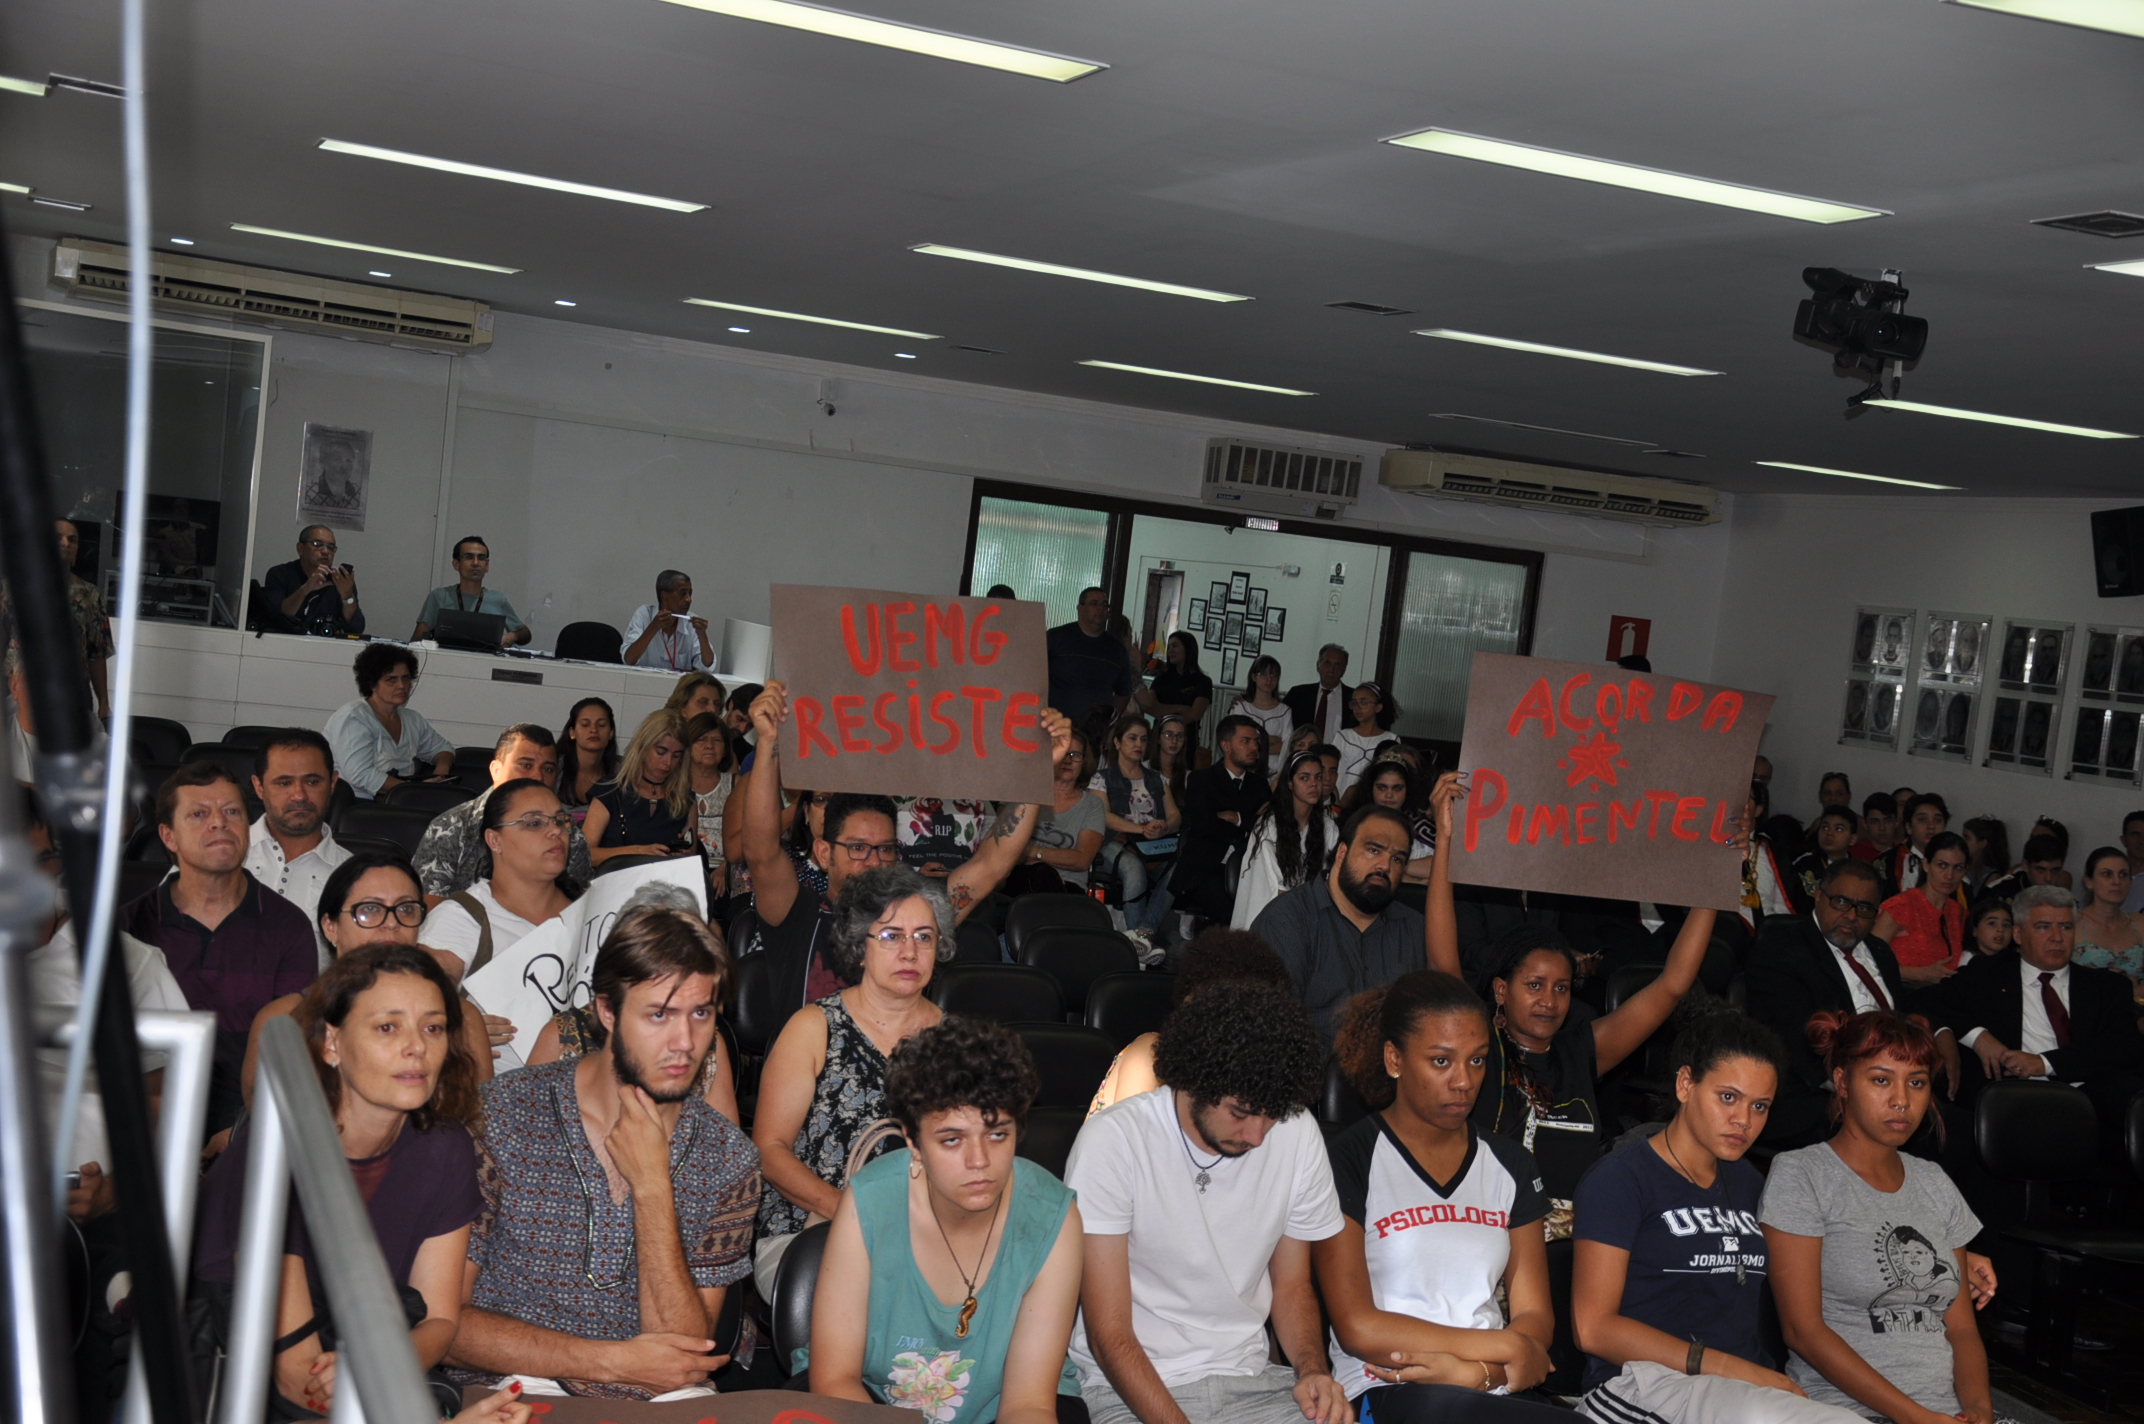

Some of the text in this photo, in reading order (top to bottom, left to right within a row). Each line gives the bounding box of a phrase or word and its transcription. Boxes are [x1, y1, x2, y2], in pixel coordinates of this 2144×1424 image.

[840, 601, 1008, 676] UEMG
[1507, 672, 1743, 739] ACORDA
[1464, 768, 1734, 853] PIMENTEL
[1689, 1254, 1765, 1267] JORNALISMO
